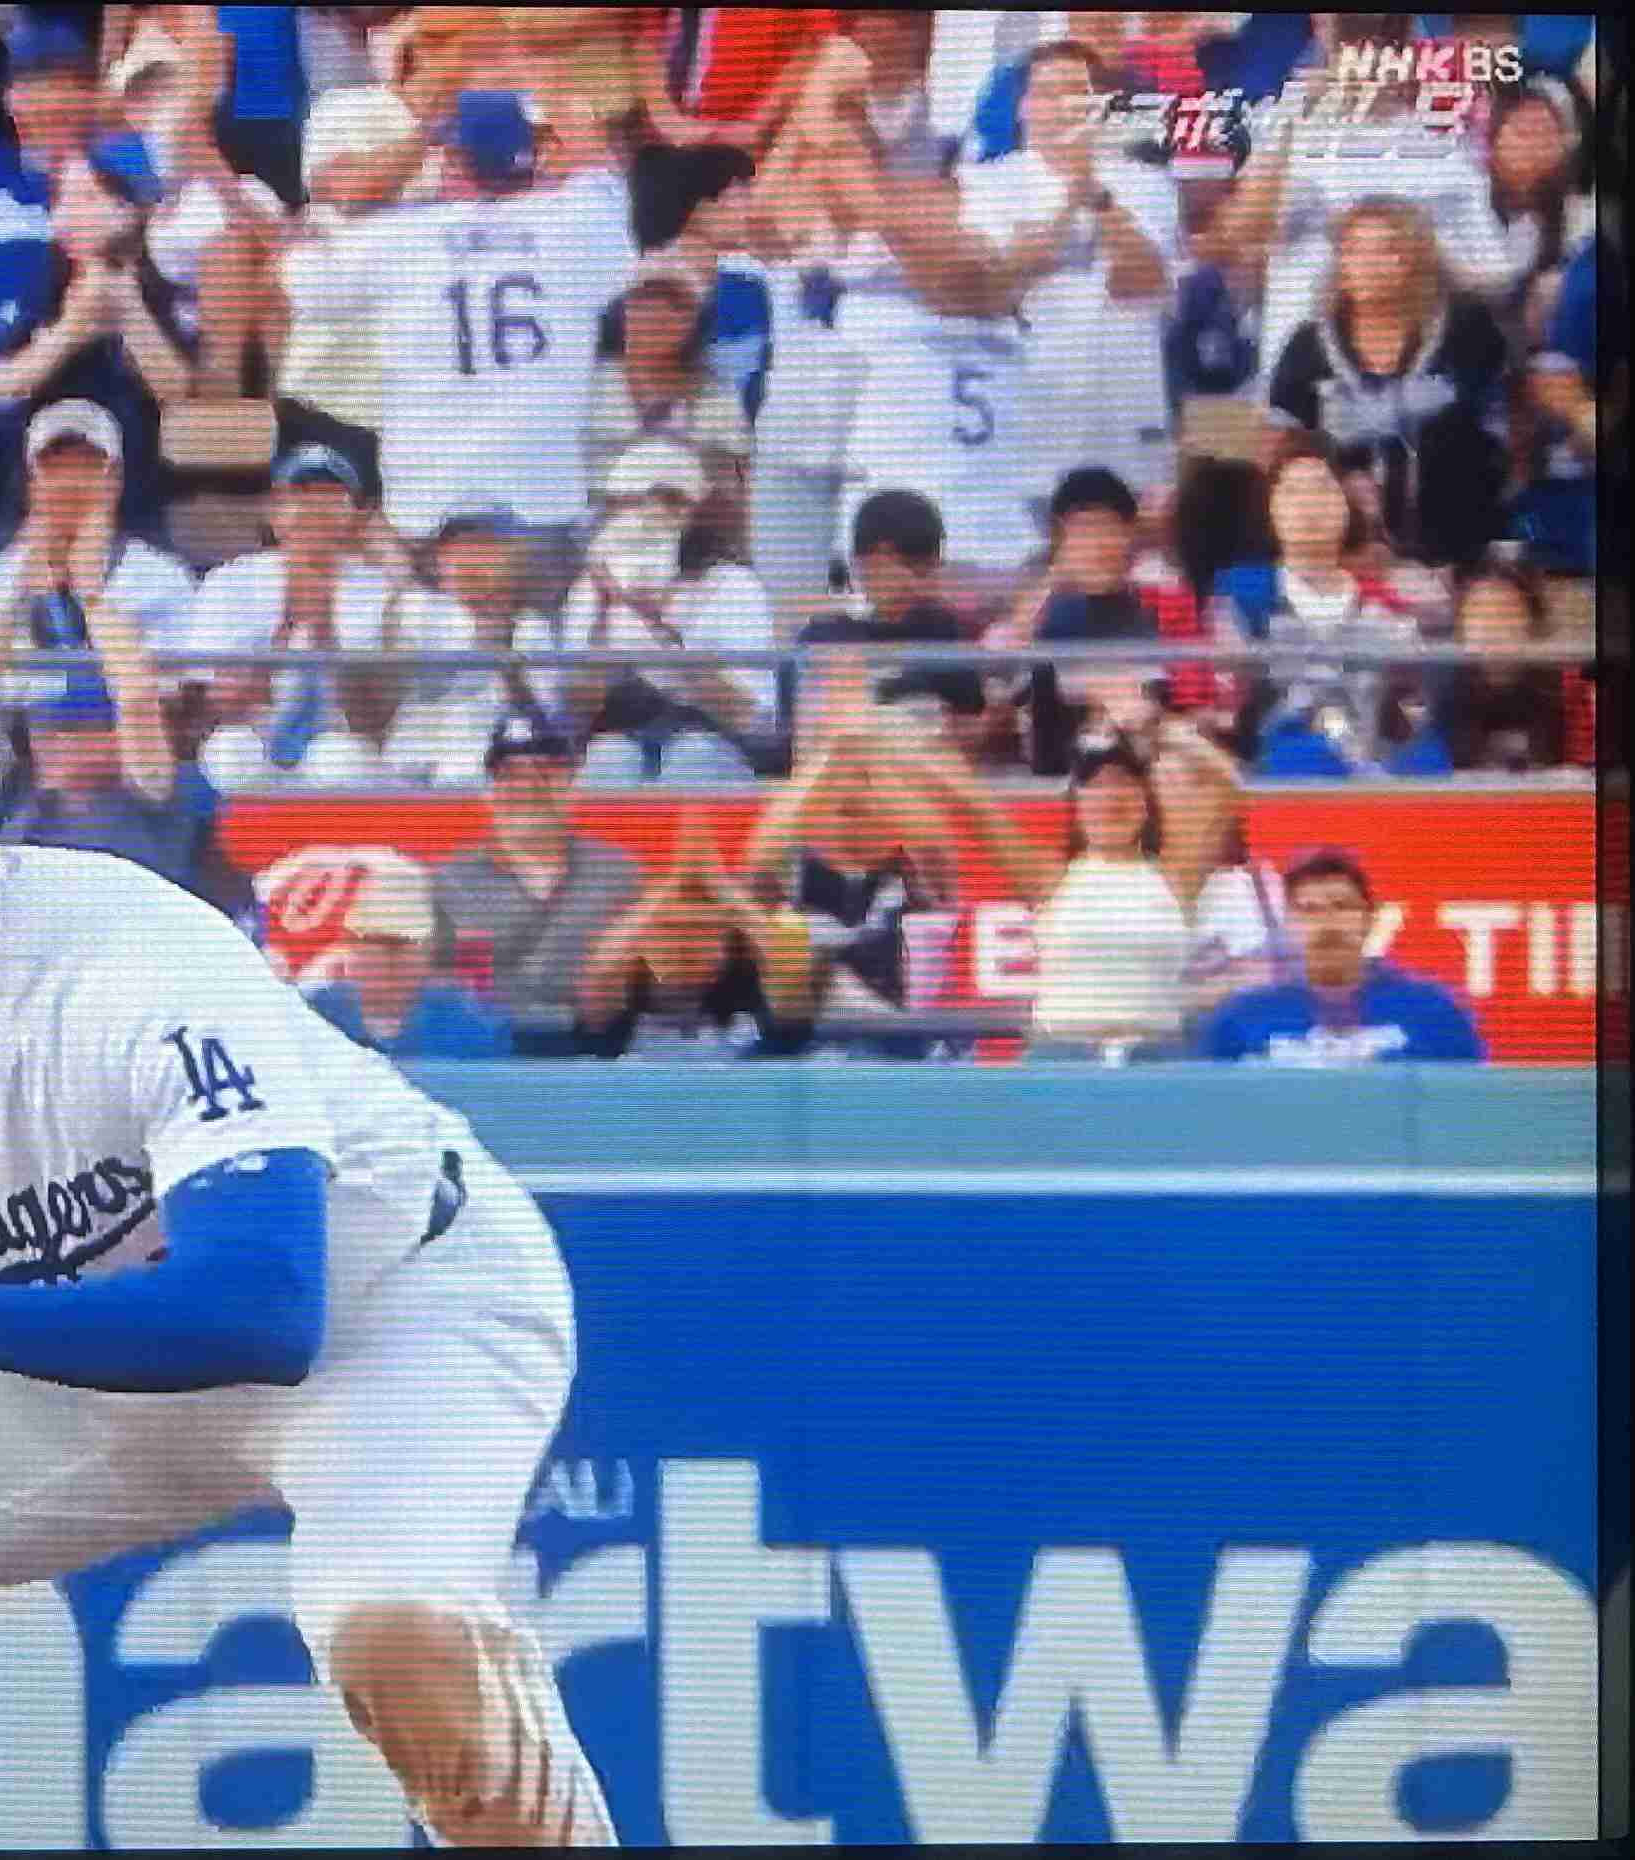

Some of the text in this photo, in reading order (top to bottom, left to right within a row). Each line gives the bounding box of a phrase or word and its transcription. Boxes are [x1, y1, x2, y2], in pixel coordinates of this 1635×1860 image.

[442, 272, 550, 376] 16
[949, 366, 996, 446] 5
[160, 1024, 266, 1122] LA
